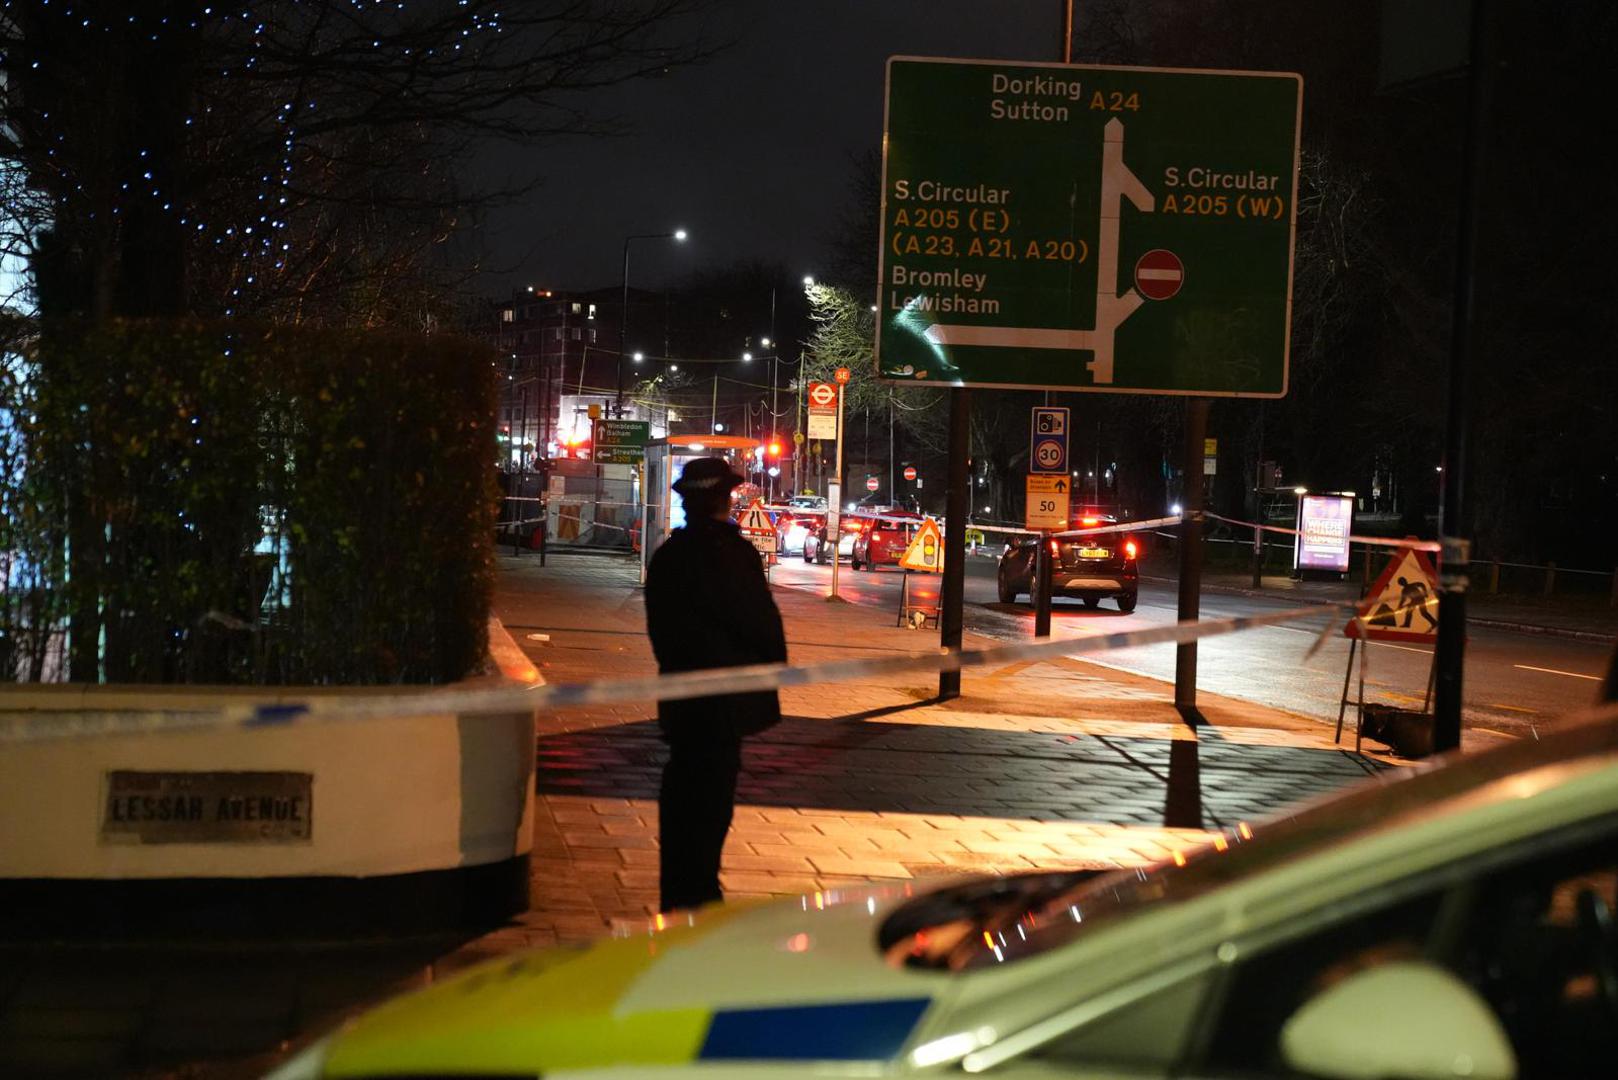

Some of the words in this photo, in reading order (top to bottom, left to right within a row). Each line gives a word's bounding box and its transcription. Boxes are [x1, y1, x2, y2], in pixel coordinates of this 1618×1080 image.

[992, 74, 1081, 99] Dorking
[991, 100, 1069, 121] Sutton
[1090, 91, 1140, 111] A24
[1163, 194, 1229, 215] A205
[1237, 195, 1284, 220] (W)
[894, 209, 959, 228] A205
[969, 210, 1010, 233] (E)
[1025, 240, 1089, 263] A20)
[892, 265, 987, 291] Bromley
[607, 422, 643, 430] Wimbledon
[1040, 449, 1059, 461] 30
[1040, 501, 1056, 512] 50
[217, 796, 302, 821] AVENUE
